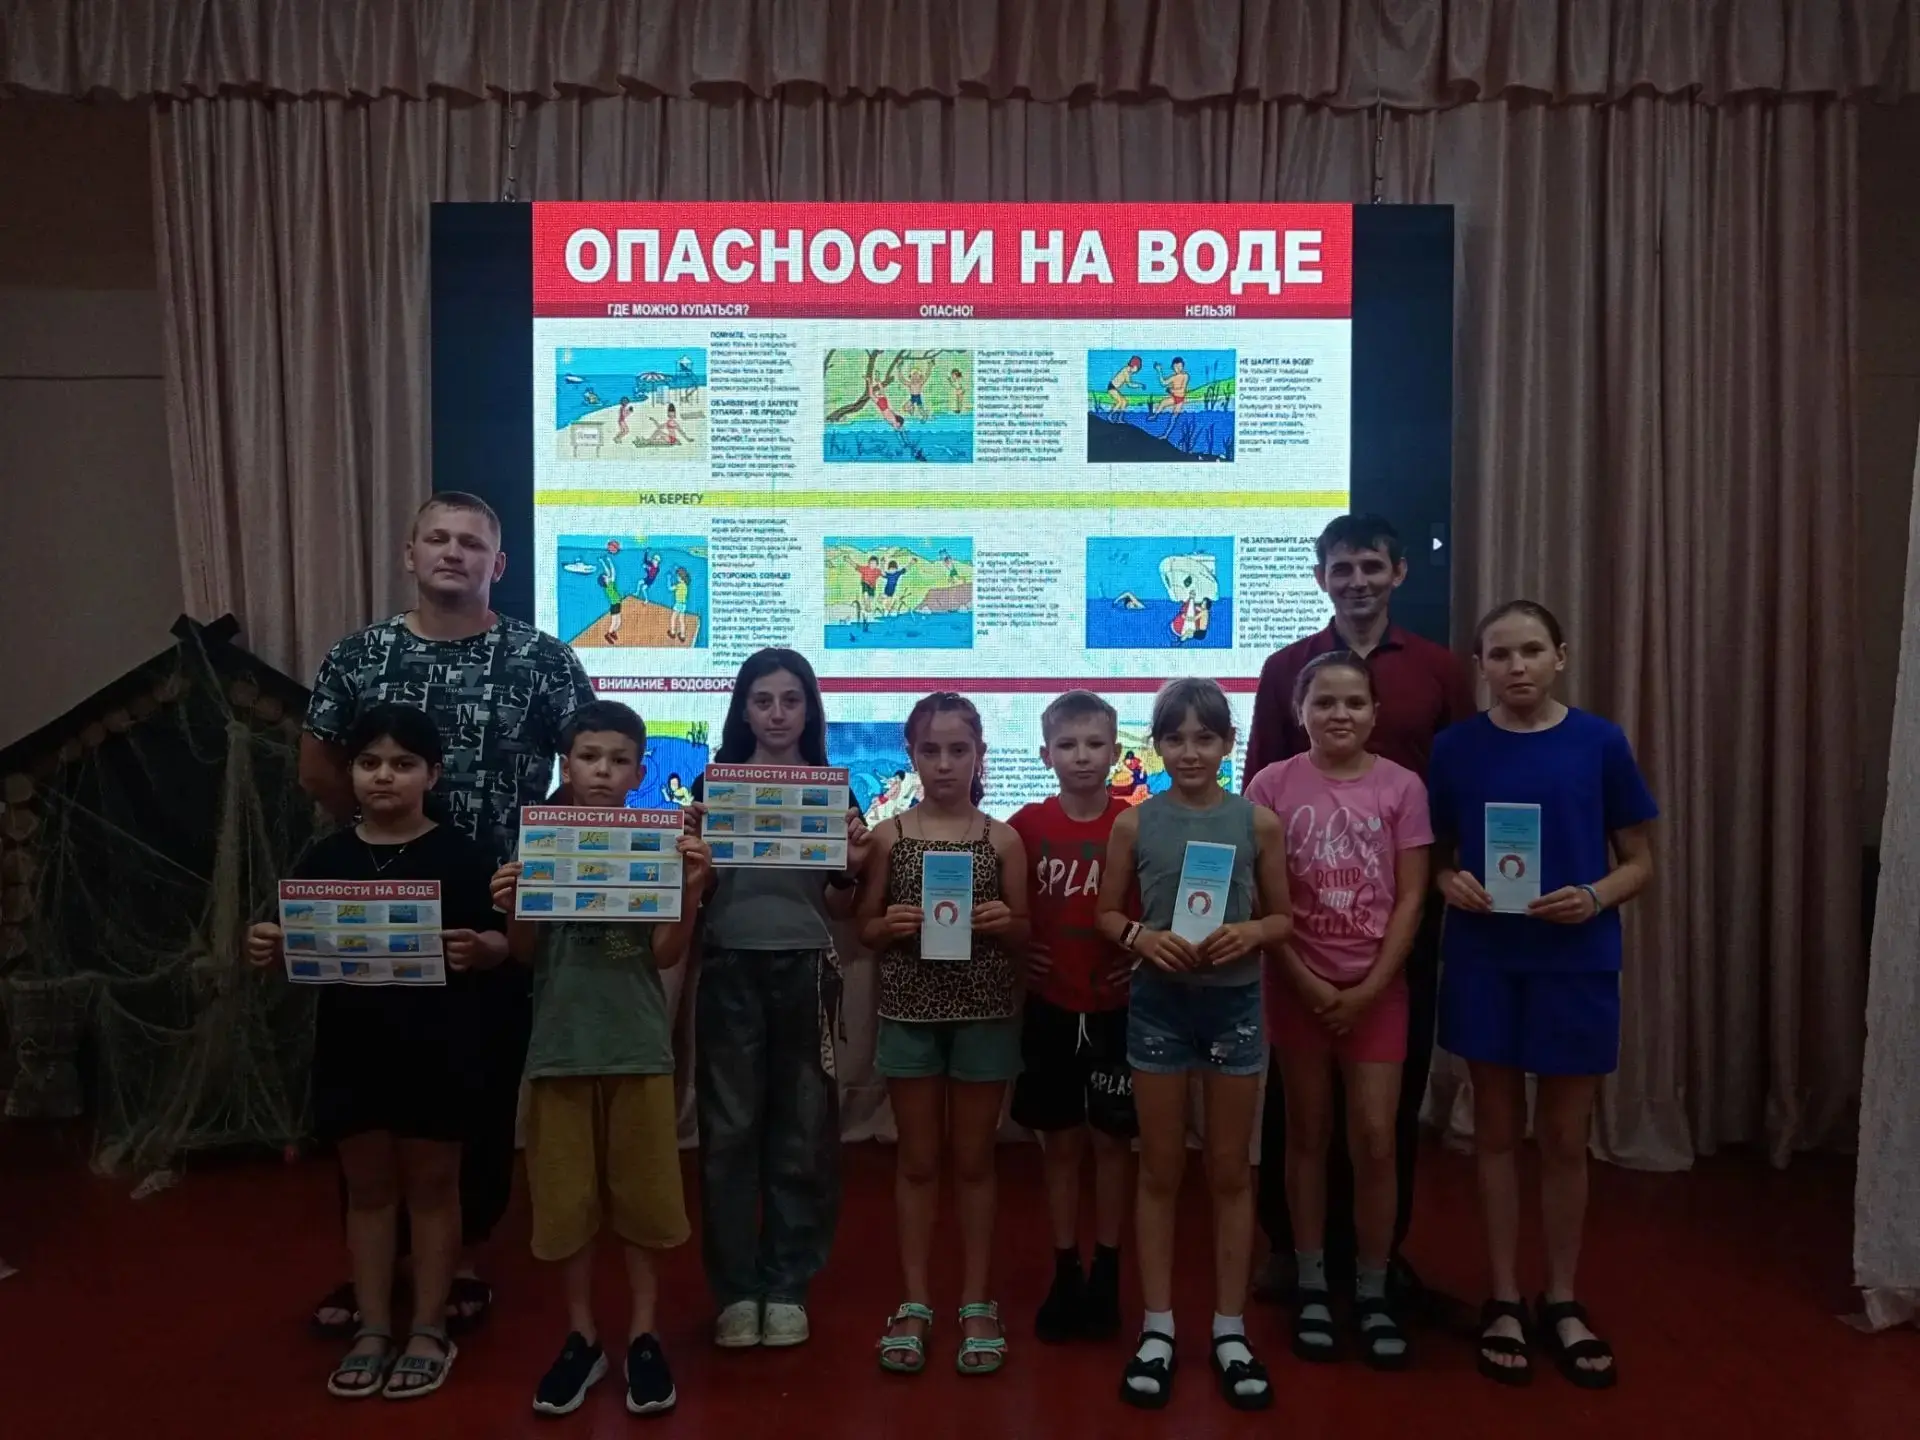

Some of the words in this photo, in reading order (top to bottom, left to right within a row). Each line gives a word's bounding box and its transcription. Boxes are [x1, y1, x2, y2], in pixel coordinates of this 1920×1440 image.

[565, 228, 997, 284] ОПАСНОСТИ
[1021, 229, 1113, 283] НА
[1138, 229, 1323, 293] ВОДЕ
[607, 303, 629, 316] ГДЕ
[632, 303, 678, 316] МОЖНО
[681, 303, 750, 316] КУПАТЬСЯ?
[919, 304, 974, 317] ОПАСНО!
[1185, 304, 1236, 318] НЕЛЬЗЯ!
[639, 493, 657, 505] НА
[659, 493, 704, 505] БЕРЕГУ
[598, 678, 668, 691] ВНИМАНИЕ,
[671, 678, 736, 691] ВОДОВОРО
[711, 768, 787, 780] ОПАСНОСТИ
[791, 770, 808, 780] НА
[812, 771, 844, 782] ВОДЕ
[528, 810, 614, 823] ОПАСНОСТИ
[619, 813, 638, 823] НА
[641, 814, 678, 825] ВОДЕ
[1036, 855, 1100, 897] SPLA
[286, 884, 370, 896] ОПАСНОСТИ
[375, 885, 394, 896] НА
[398, 885, 434, 897] ВОДЕ
[1090, 1070, 1132, 1097] SPLAS
